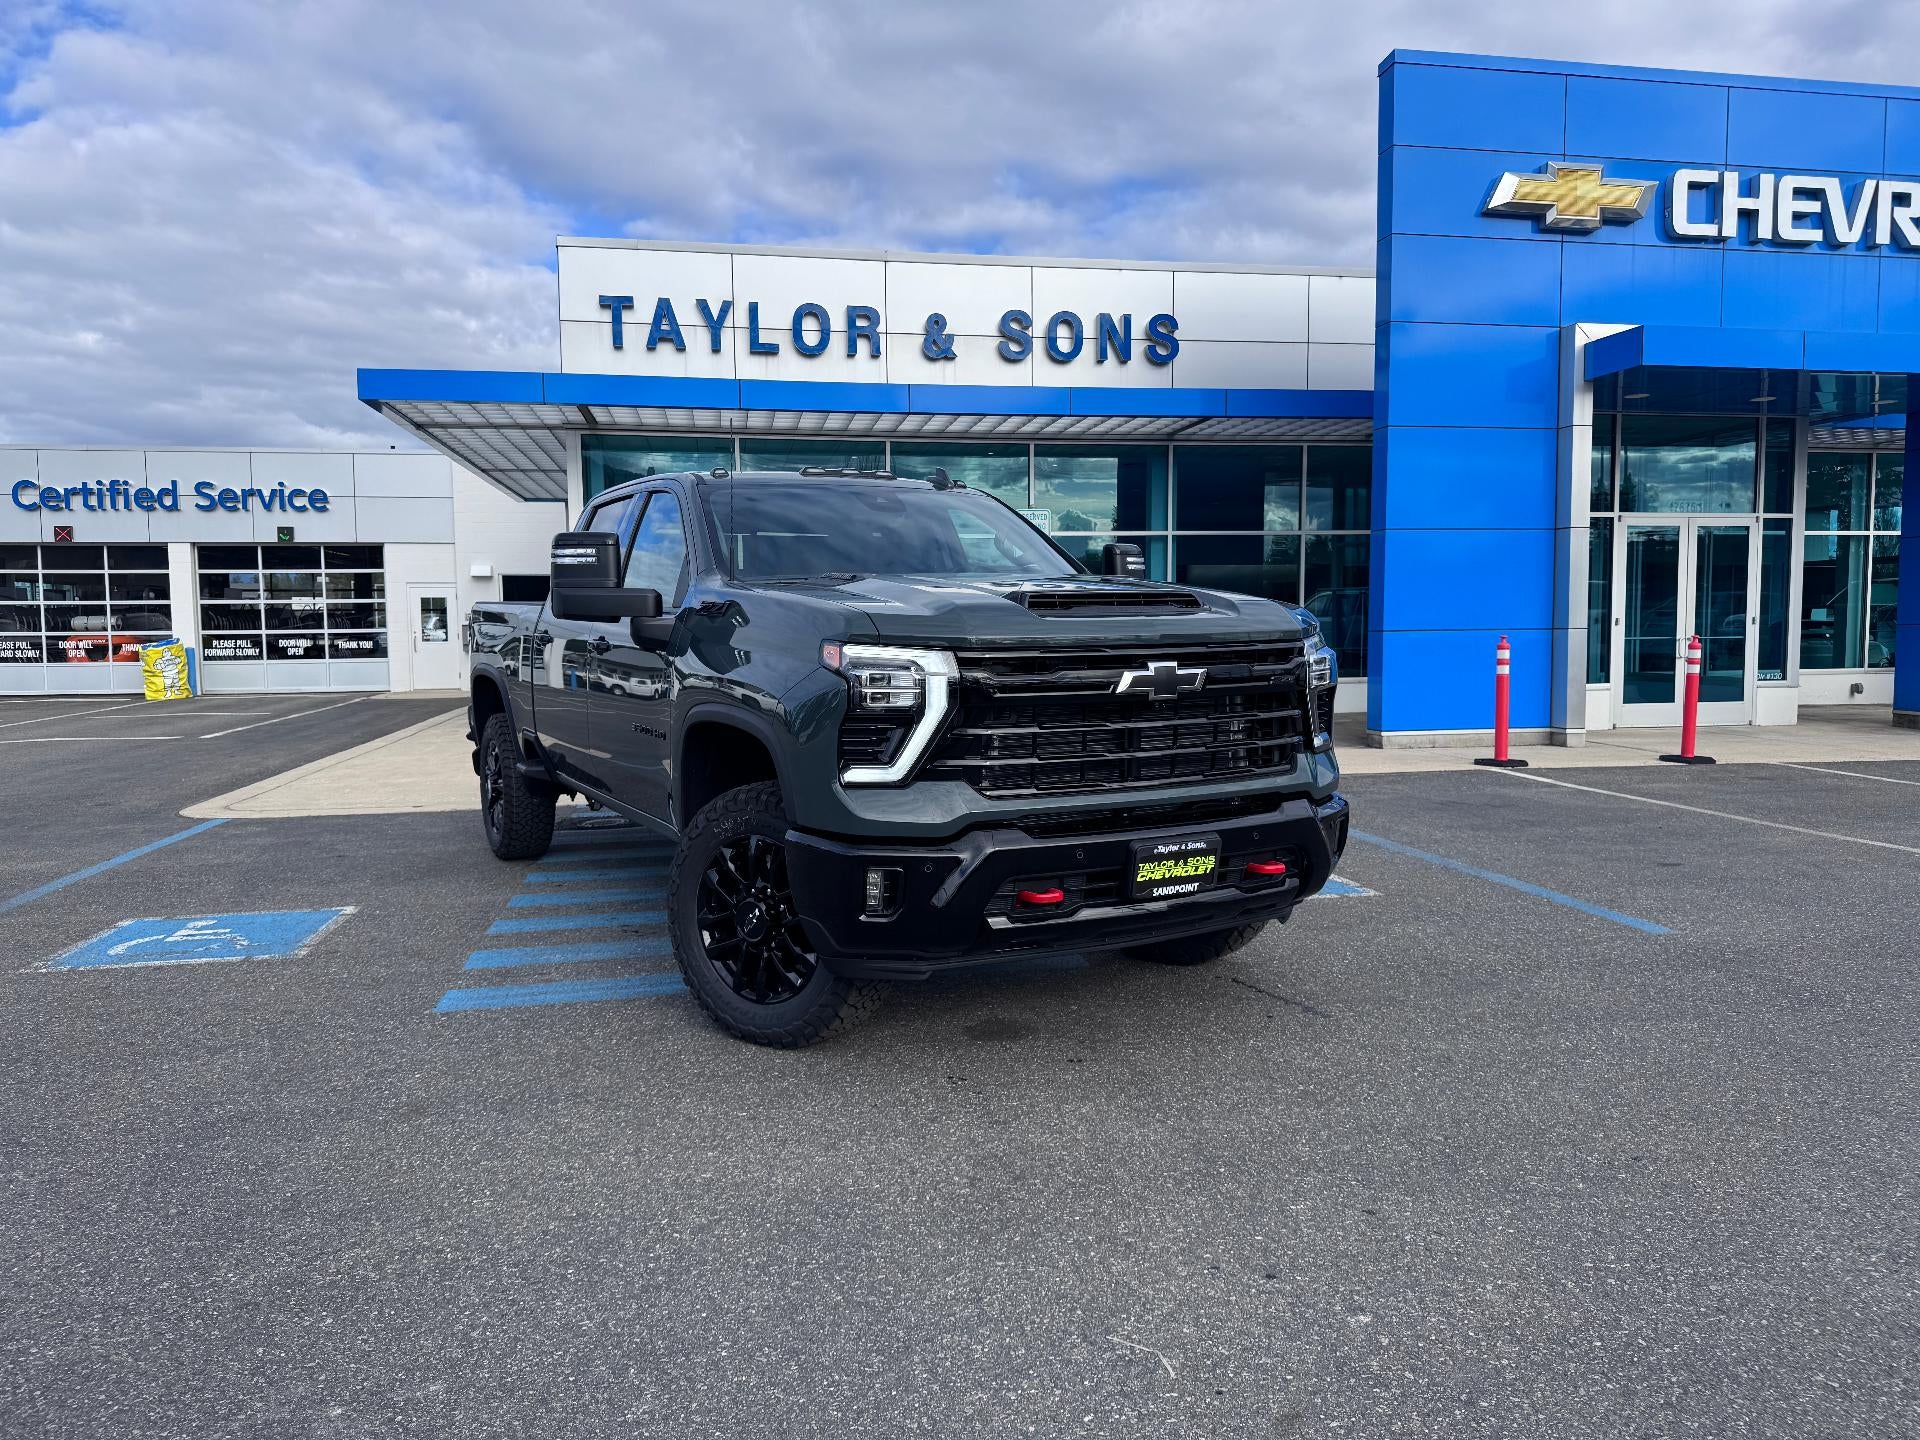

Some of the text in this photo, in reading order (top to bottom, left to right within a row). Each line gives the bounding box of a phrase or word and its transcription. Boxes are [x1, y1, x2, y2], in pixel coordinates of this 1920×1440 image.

[1672, 168, 1920, 247] CHEVR
[598, 294, 1180, 365] TAYLOR & SONS
[11, 479, 329, 512] Certified Service
[1023, 513, 1048, 521] SERVED
[16, 641, 31, 649] PULL
[59, 641, 77, 649] DOOR
[78, 640, 93, 649] WILL
[121, 643, 140, 652] THAN
[212, 640, 252, 648] PLEASE PULL
[279, 639, 312, 648] DOOR WILL
[338, 641, 374, 649] THANK YOU!
[15, 650, 40, 658] SLOWLY
[68, 649, 85, 658] OPEN
[204, 648, 260, 657] FORWARD SLOWLY
[287, 648, 304, 656] OPEN
[1157, 844, 1180, 854] Taylor
[1139, 855, 1216, 871] TAYLOR & SONS
[1136, 865, 1215, 882] CHEVROLET
[1152, 882, 1200, 897] SANDPOINT
